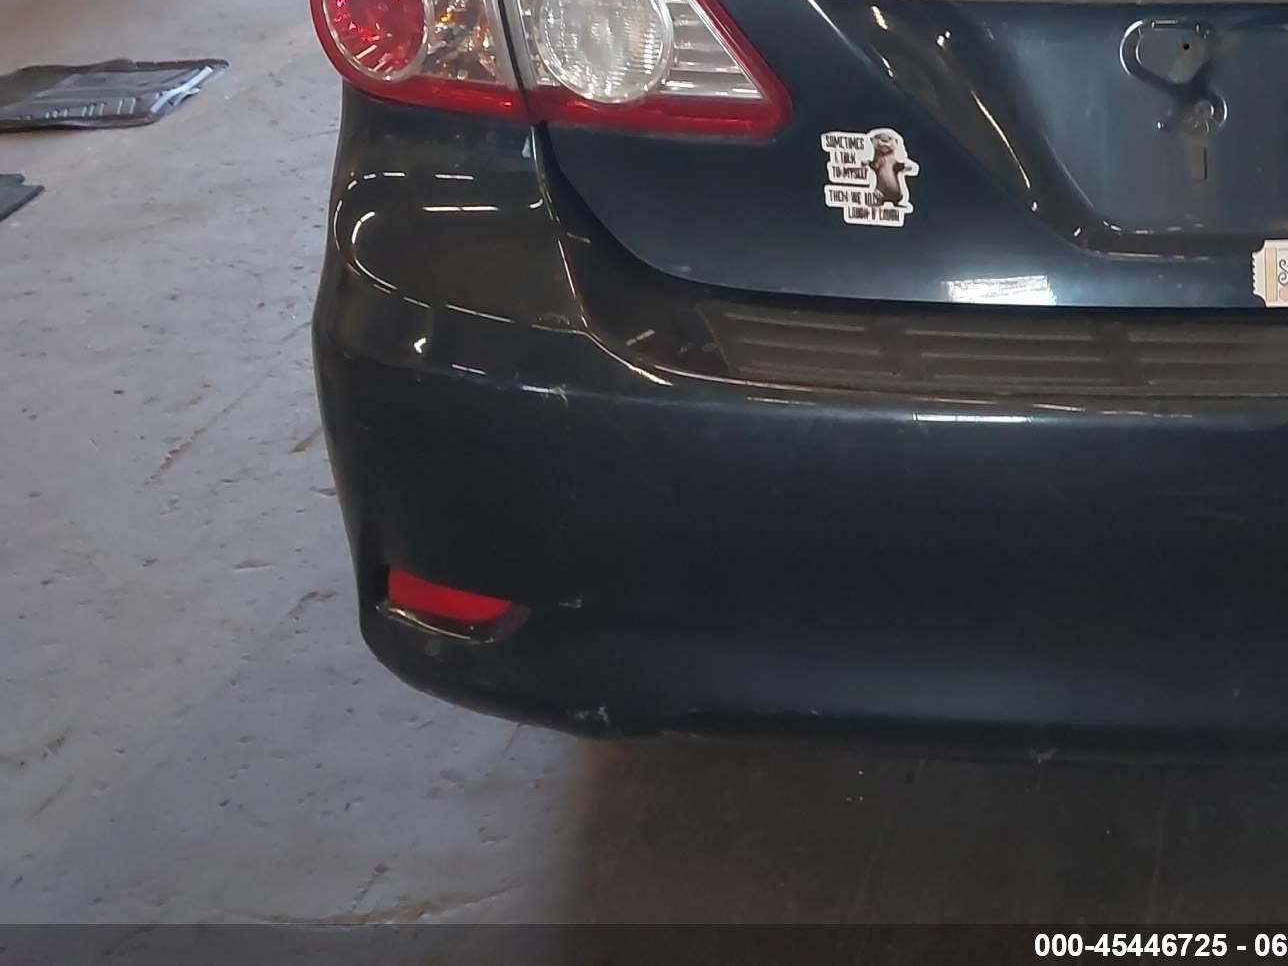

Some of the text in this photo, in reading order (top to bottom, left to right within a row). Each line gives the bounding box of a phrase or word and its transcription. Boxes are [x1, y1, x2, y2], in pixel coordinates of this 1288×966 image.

[825, 135, 865, 150] SOMETIMES
[832, 166, 868, 180] TO MYSELF
[829, 189, 848, 203] THEN
